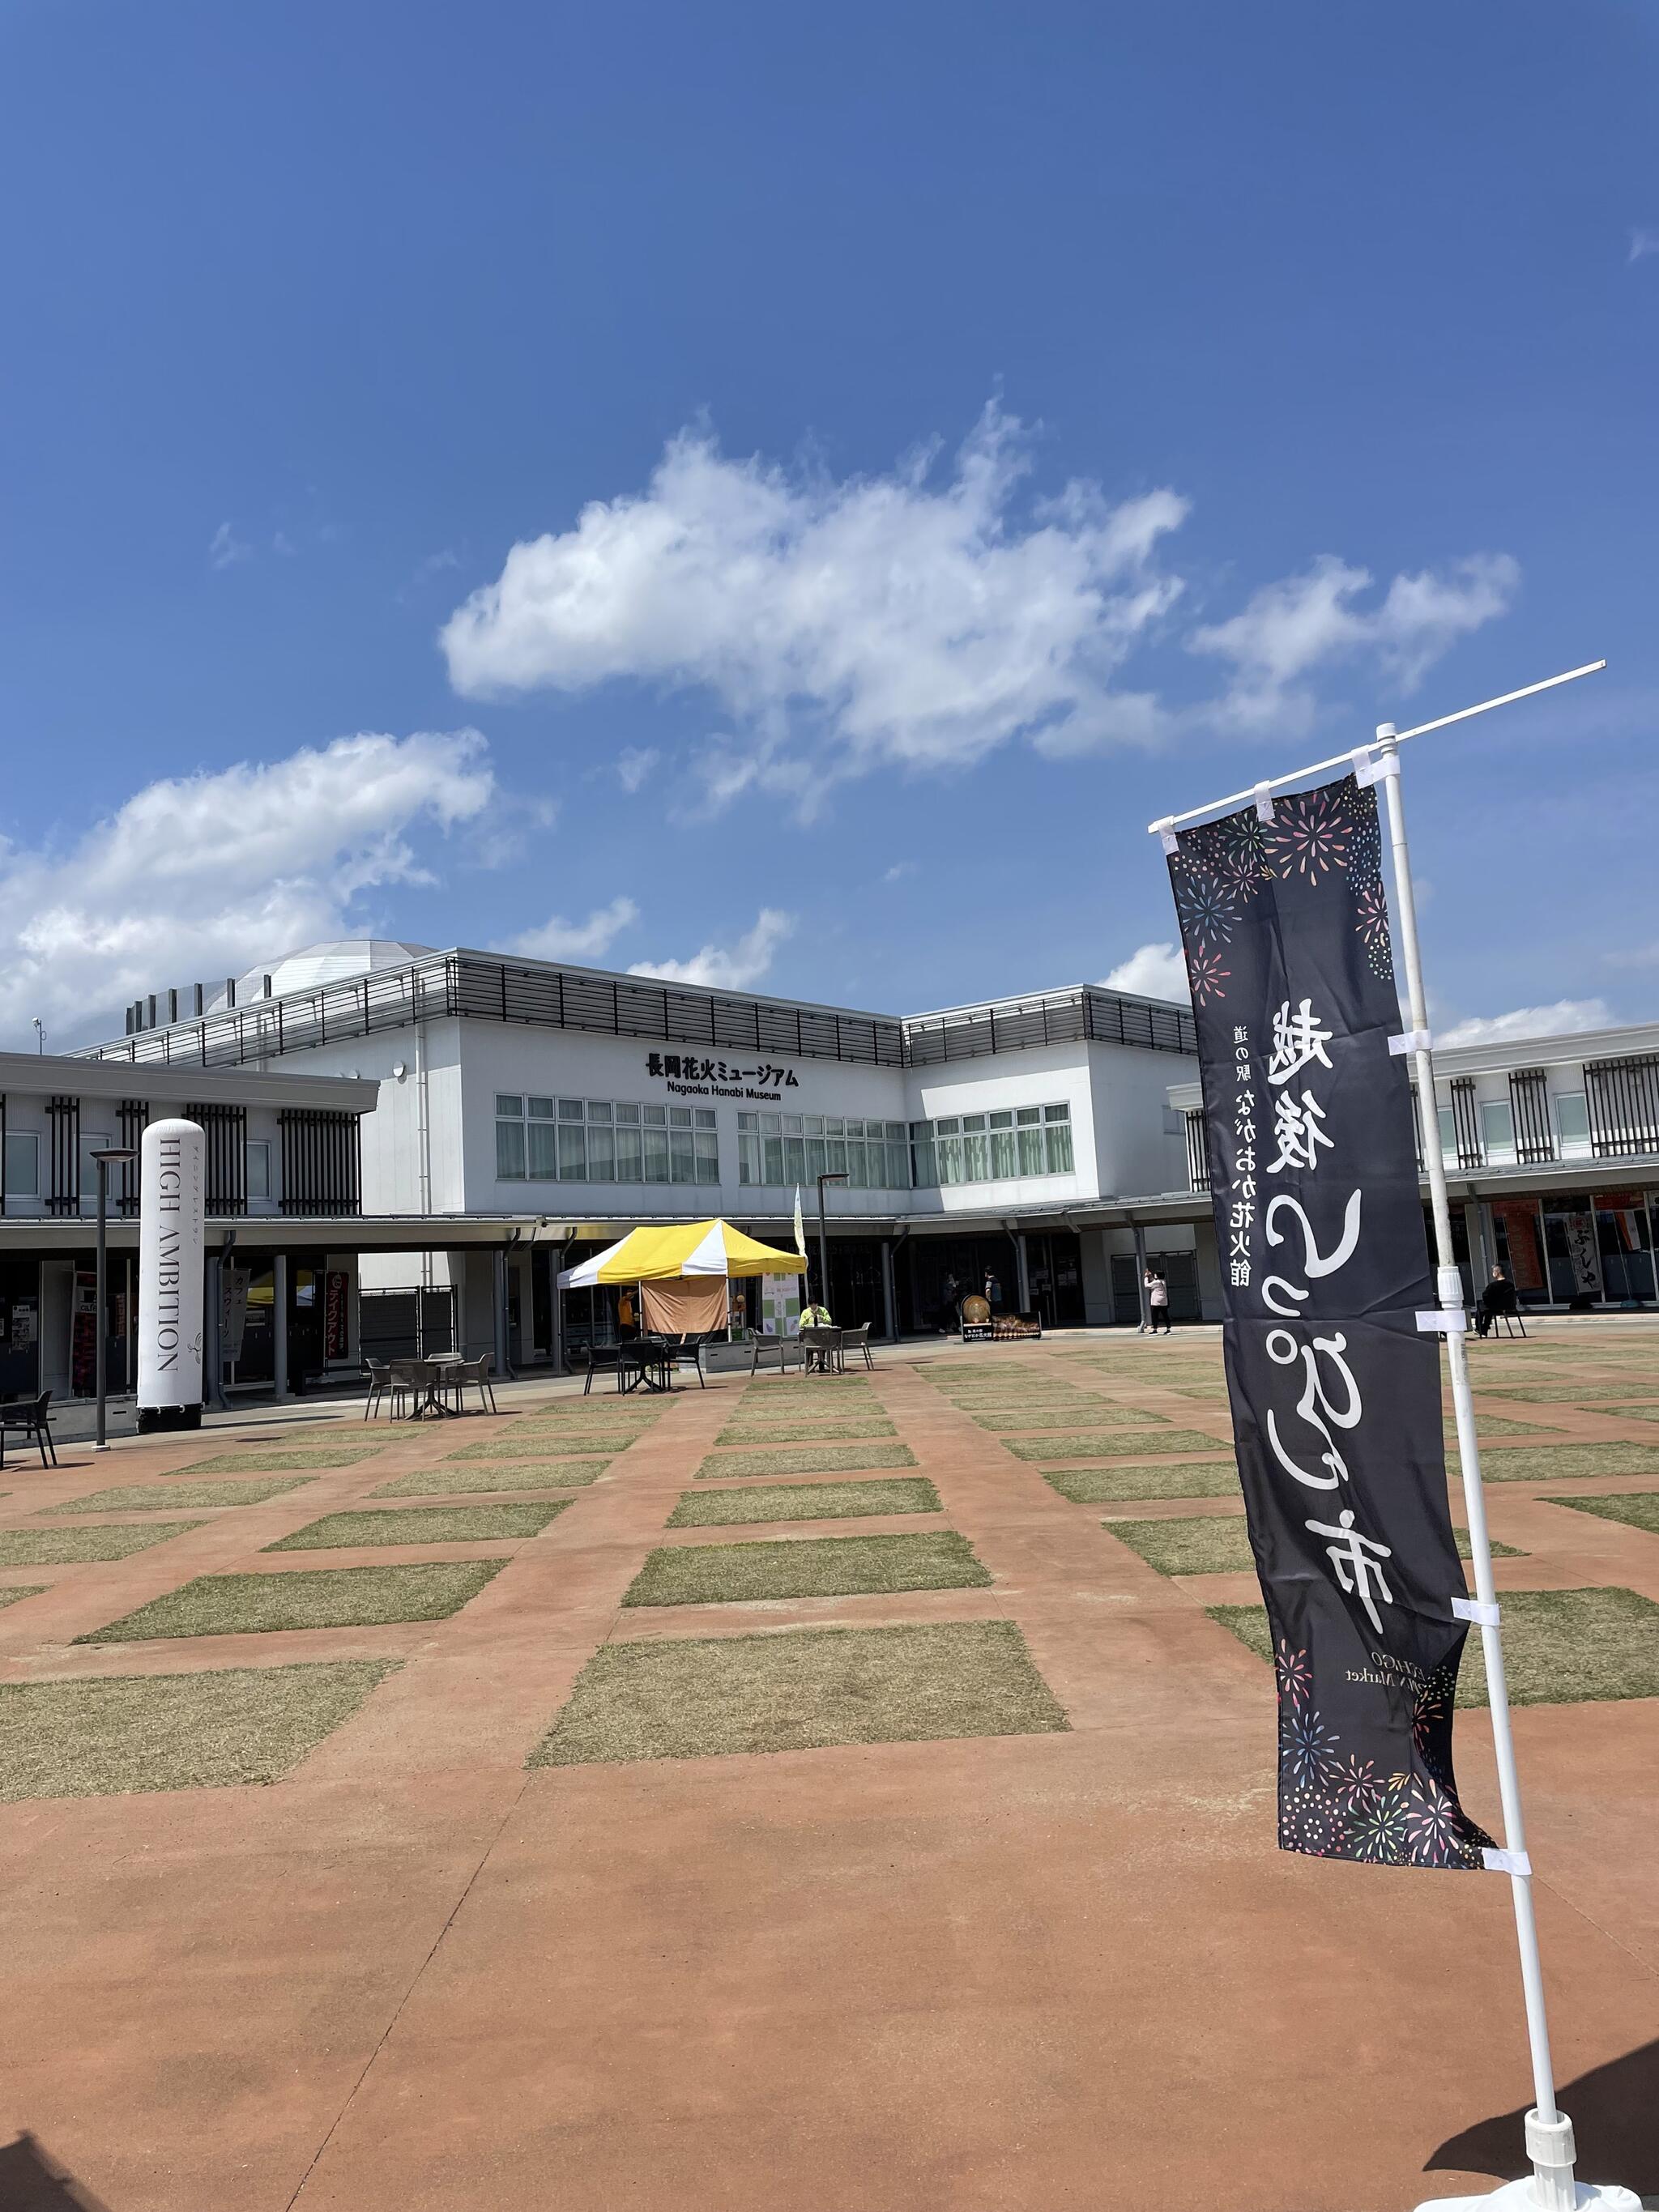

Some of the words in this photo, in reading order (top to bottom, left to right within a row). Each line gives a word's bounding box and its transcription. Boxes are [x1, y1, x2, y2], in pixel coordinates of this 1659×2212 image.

[646, 1053, 799, 1087] 長岡花火ミュージアム
[667, 1081, 709, 1096] Nagaoka
[711, 1085, 744, 1098] Hanabi
[746, 1088, 782, 1101] Museum
[160, 1138, 181, 1212] HIGH
[157, 1225, 181, 1372] AMBITION
[235, 1276, 243, 1305] カフェ
[327, 1289, 339, 1356] テイクアウト
